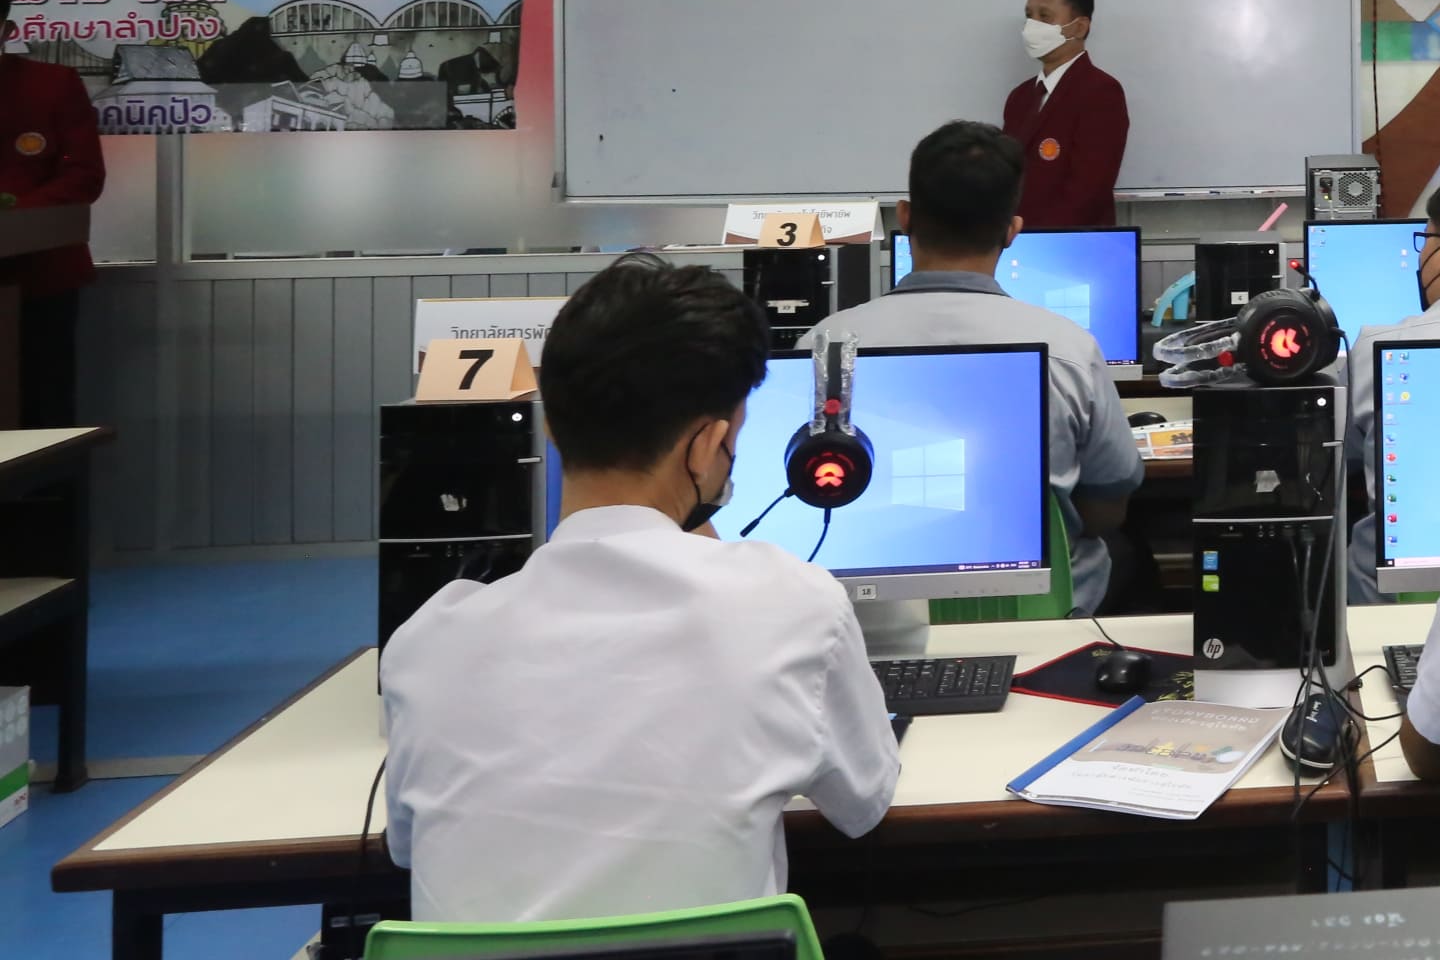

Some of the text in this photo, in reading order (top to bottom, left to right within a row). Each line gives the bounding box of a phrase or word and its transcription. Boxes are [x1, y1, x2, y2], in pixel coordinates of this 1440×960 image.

[102, 96, 212, 126] คนิคปัว
[776, 222, 798, 246] 3
[458, 349, 495, 390] 7
[1205, 639, 1222, 659] hp
